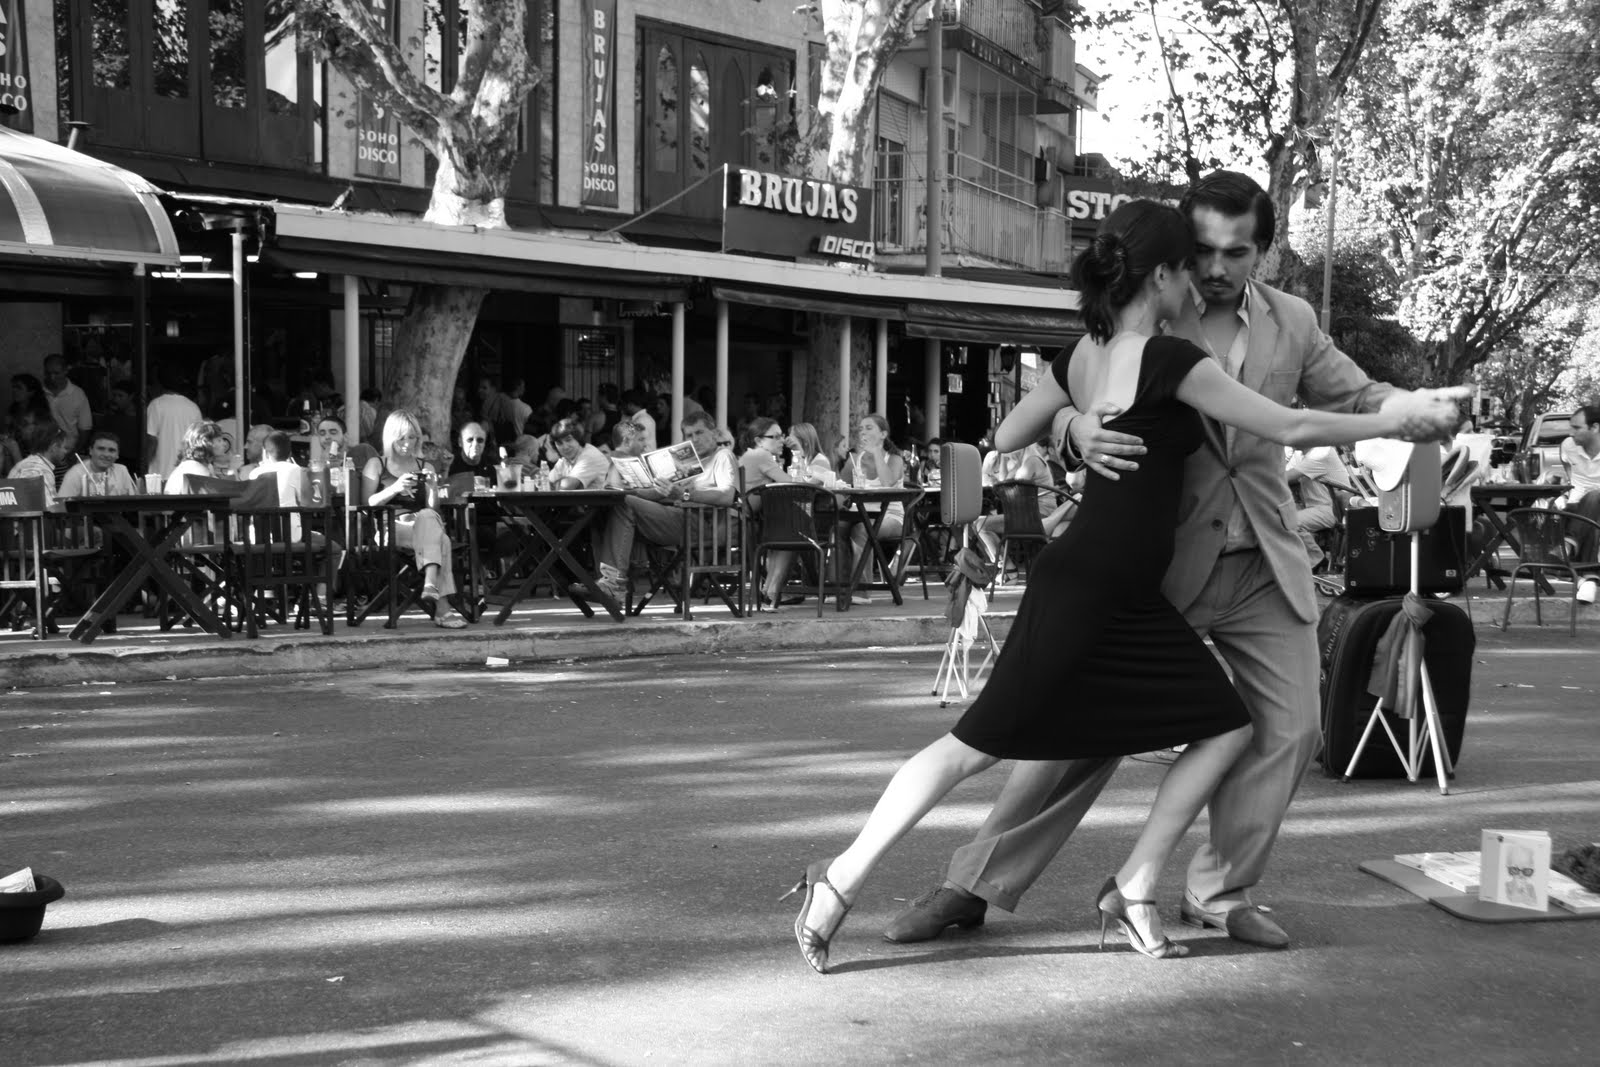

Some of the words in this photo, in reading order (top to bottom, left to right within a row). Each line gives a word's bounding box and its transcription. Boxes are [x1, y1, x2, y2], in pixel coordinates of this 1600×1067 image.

[593, 9, 606, 152] BRUJAS
[359, 128, 398, 146] SOHO
[358, 145, 398, 164] DISCO
[583, 161, 616, 176] SOHO
[583, 176, 616, 192] DISCO
[739, 168, 859, 224] BRUJAS
[820, 235, 876, 260] DISCO
